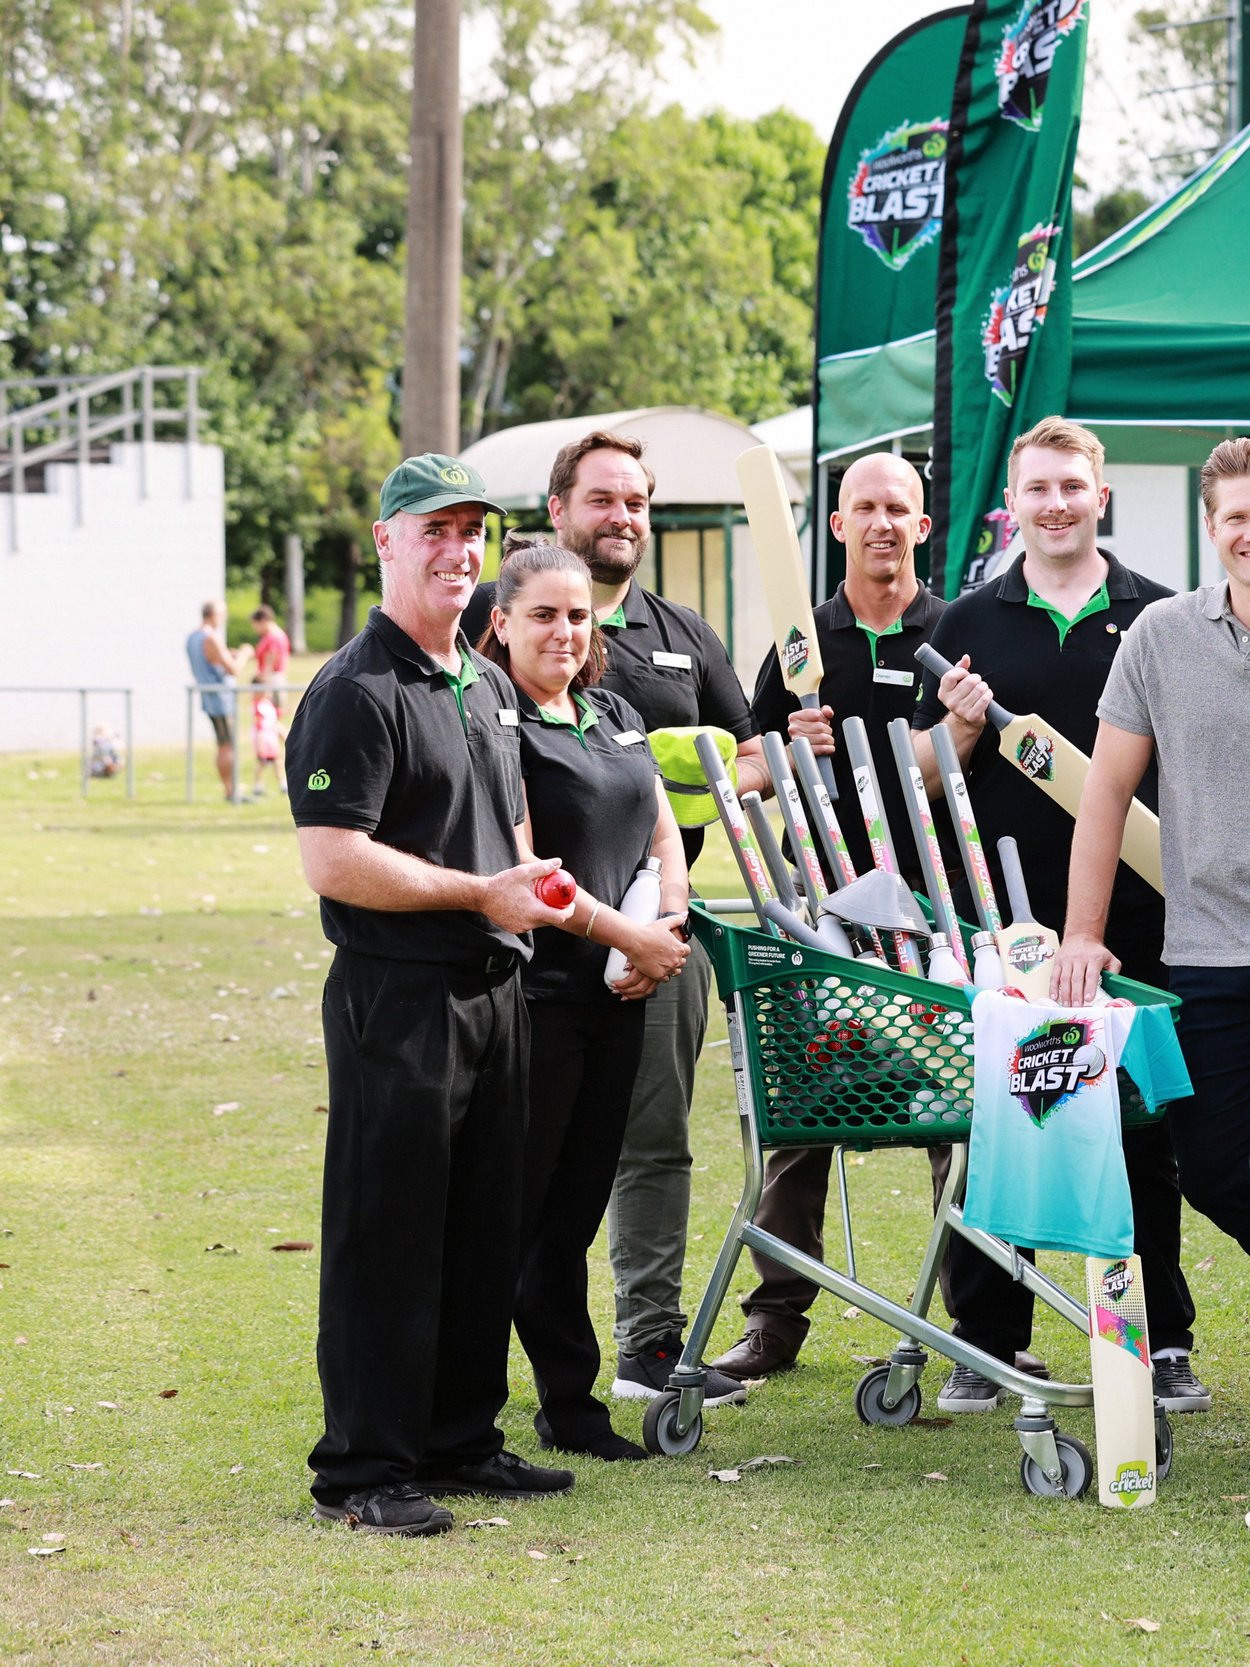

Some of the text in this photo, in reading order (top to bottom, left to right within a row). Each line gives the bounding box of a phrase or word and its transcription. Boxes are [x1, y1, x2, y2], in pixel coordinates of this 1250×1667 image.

[862, 162, 939, 194] CRICKET
[849, 184, 945, 223] BLAST
[747, 944, 767, 952] PUSHING
[1008, 951, 1047, 964] BLAST
[1018, 1048, 1074, 1070] CRICKET
[1010, 1065, 1088, 1093] BLAST
[1102, 1279, 1130, 1294] BLAST
[1109, 1472, 1153, 1493] cricket
[1120, 1469, 1140, 1481] play
